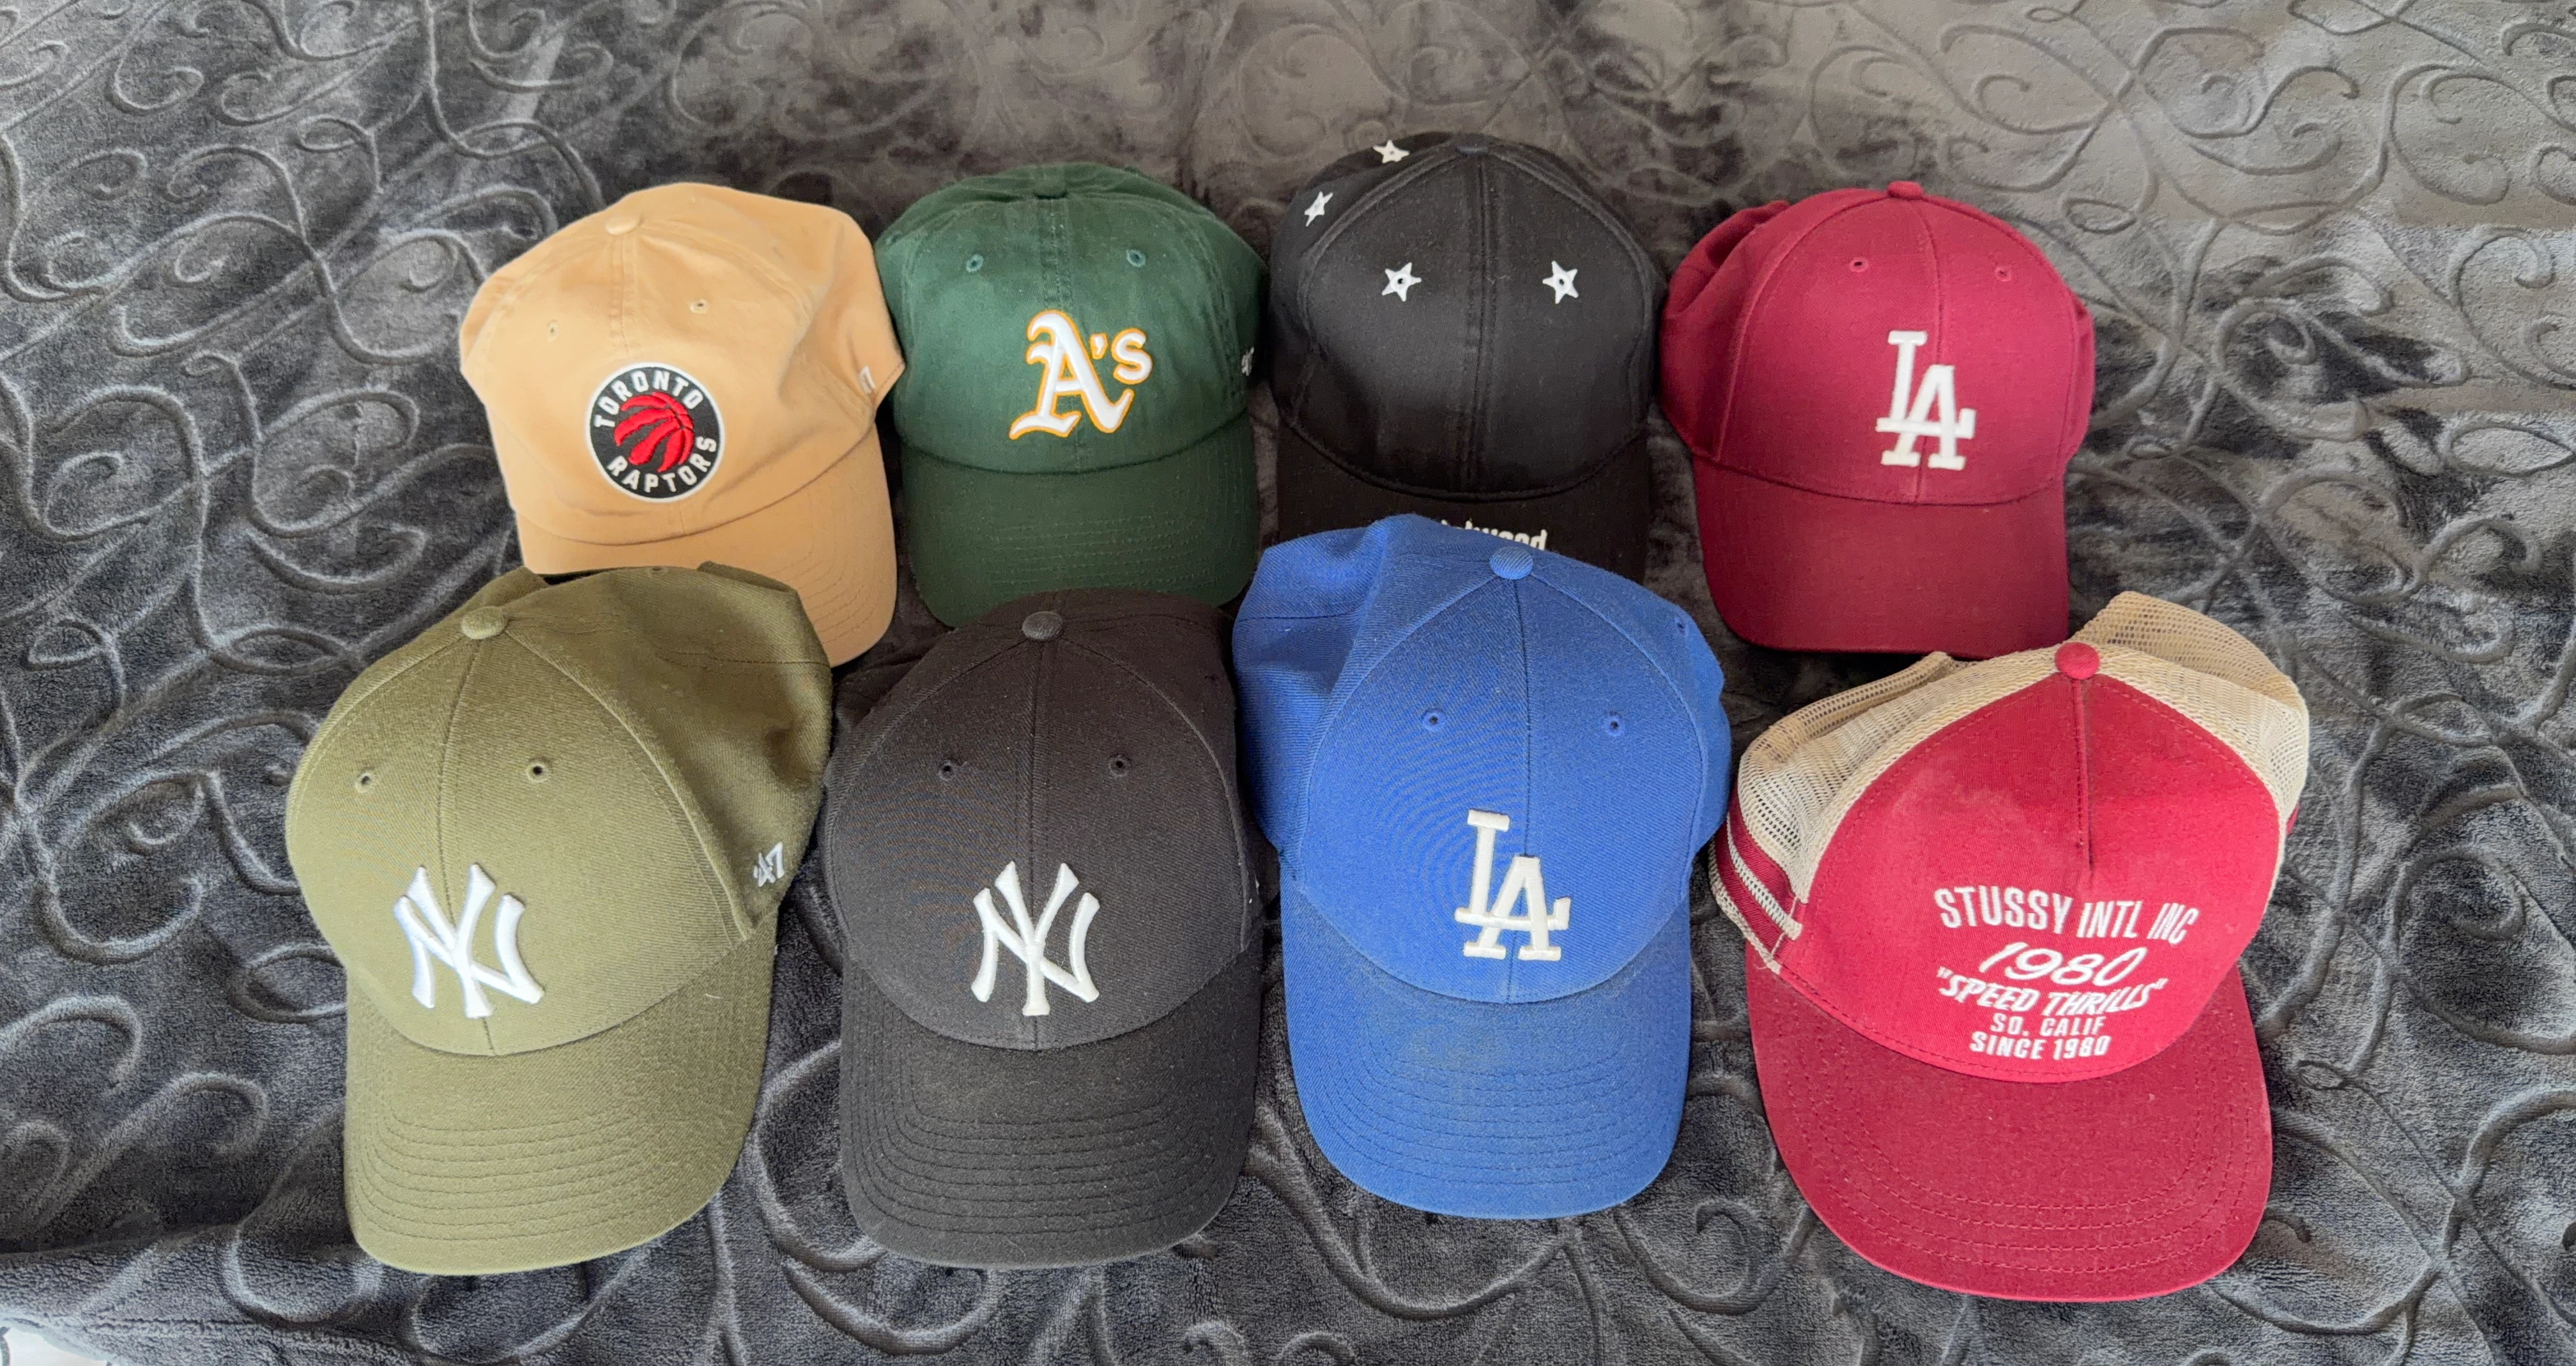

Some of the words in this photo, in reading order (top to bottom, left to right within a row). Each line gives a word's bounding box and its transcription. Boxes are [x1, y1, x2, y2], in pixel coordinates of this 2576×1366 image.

[594, 370, 703, 427] TORONTO
[1009, 309, 1153, 440] A's
[1875, 330, 1977, 470] LA
[608, 436, 716, 493] RAPTORS
[1454, 808, 1572, 961] LA
[393, 863, 546, 1018] NY
[971, 861, 1100, 1016] NY
[1935, 885, 2073, 934] STUSSY
[2076, 900, 2144, 938] INTL
[2146, 902, 2200, 945] INC
[1936, 966, 2041, 1011] "SPEED
[2041, 978, 2168, 1016] THRILLS"
[1979, 942, 2147, 986] 1980
[1970, 1031, 2046, 1060] SINCE
[2053, 1036, 2111, 1060] 1980
[2039, 1016, 2106, 1036] CALIF
